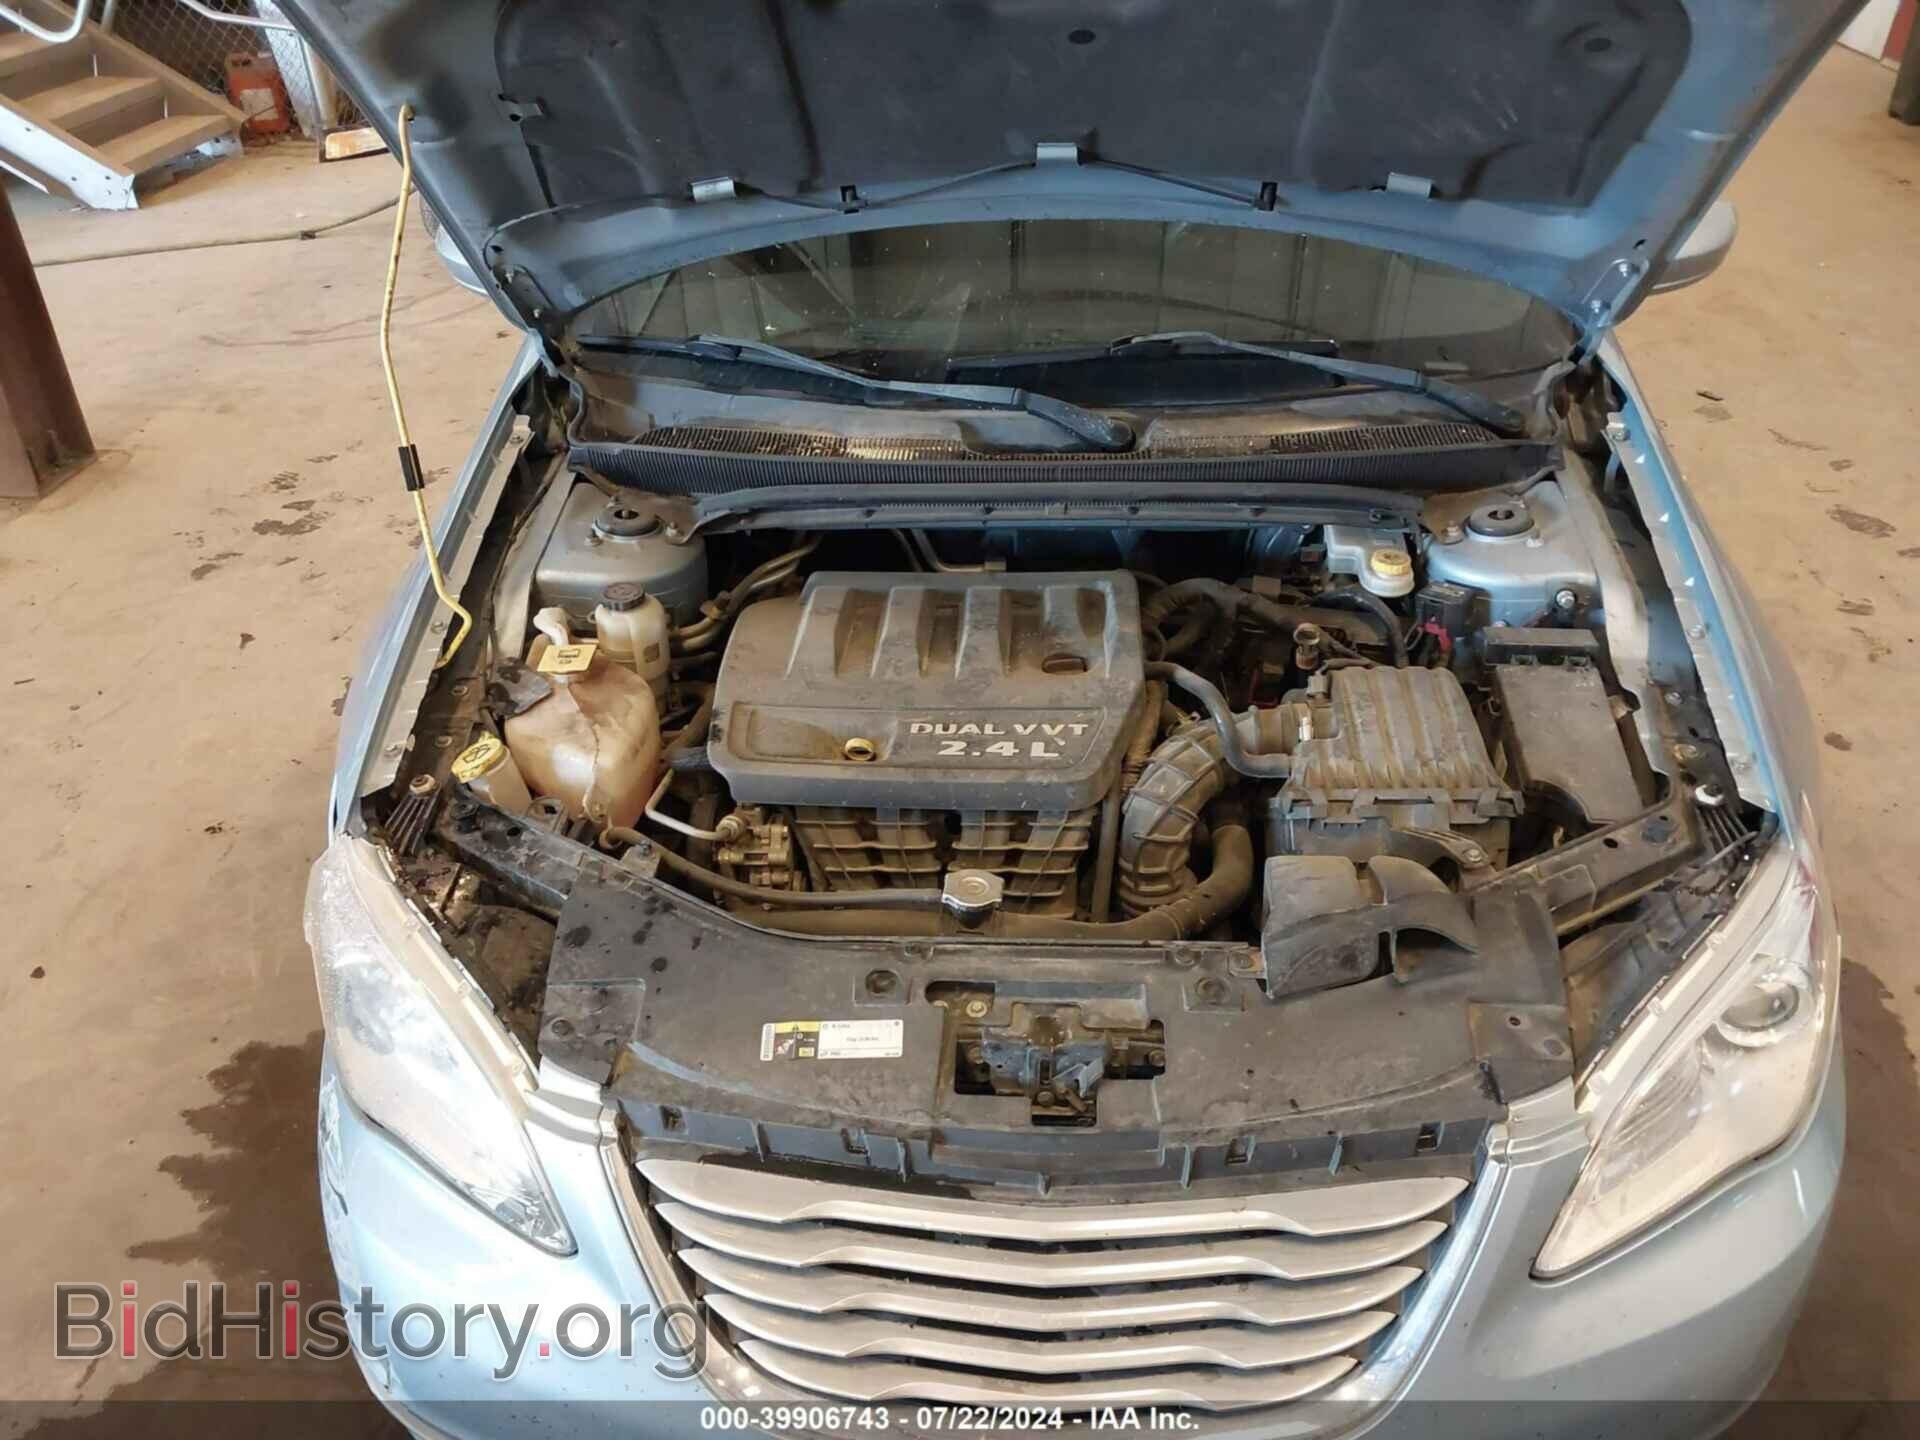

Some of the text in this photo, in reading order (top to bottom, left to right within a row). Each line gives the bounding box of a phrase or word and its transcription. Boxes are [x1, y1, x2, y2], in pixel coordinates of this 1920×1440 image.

[909, 722, 1089, 736] DUAL VVT
[937, 739, 1020, 757] 2.4
